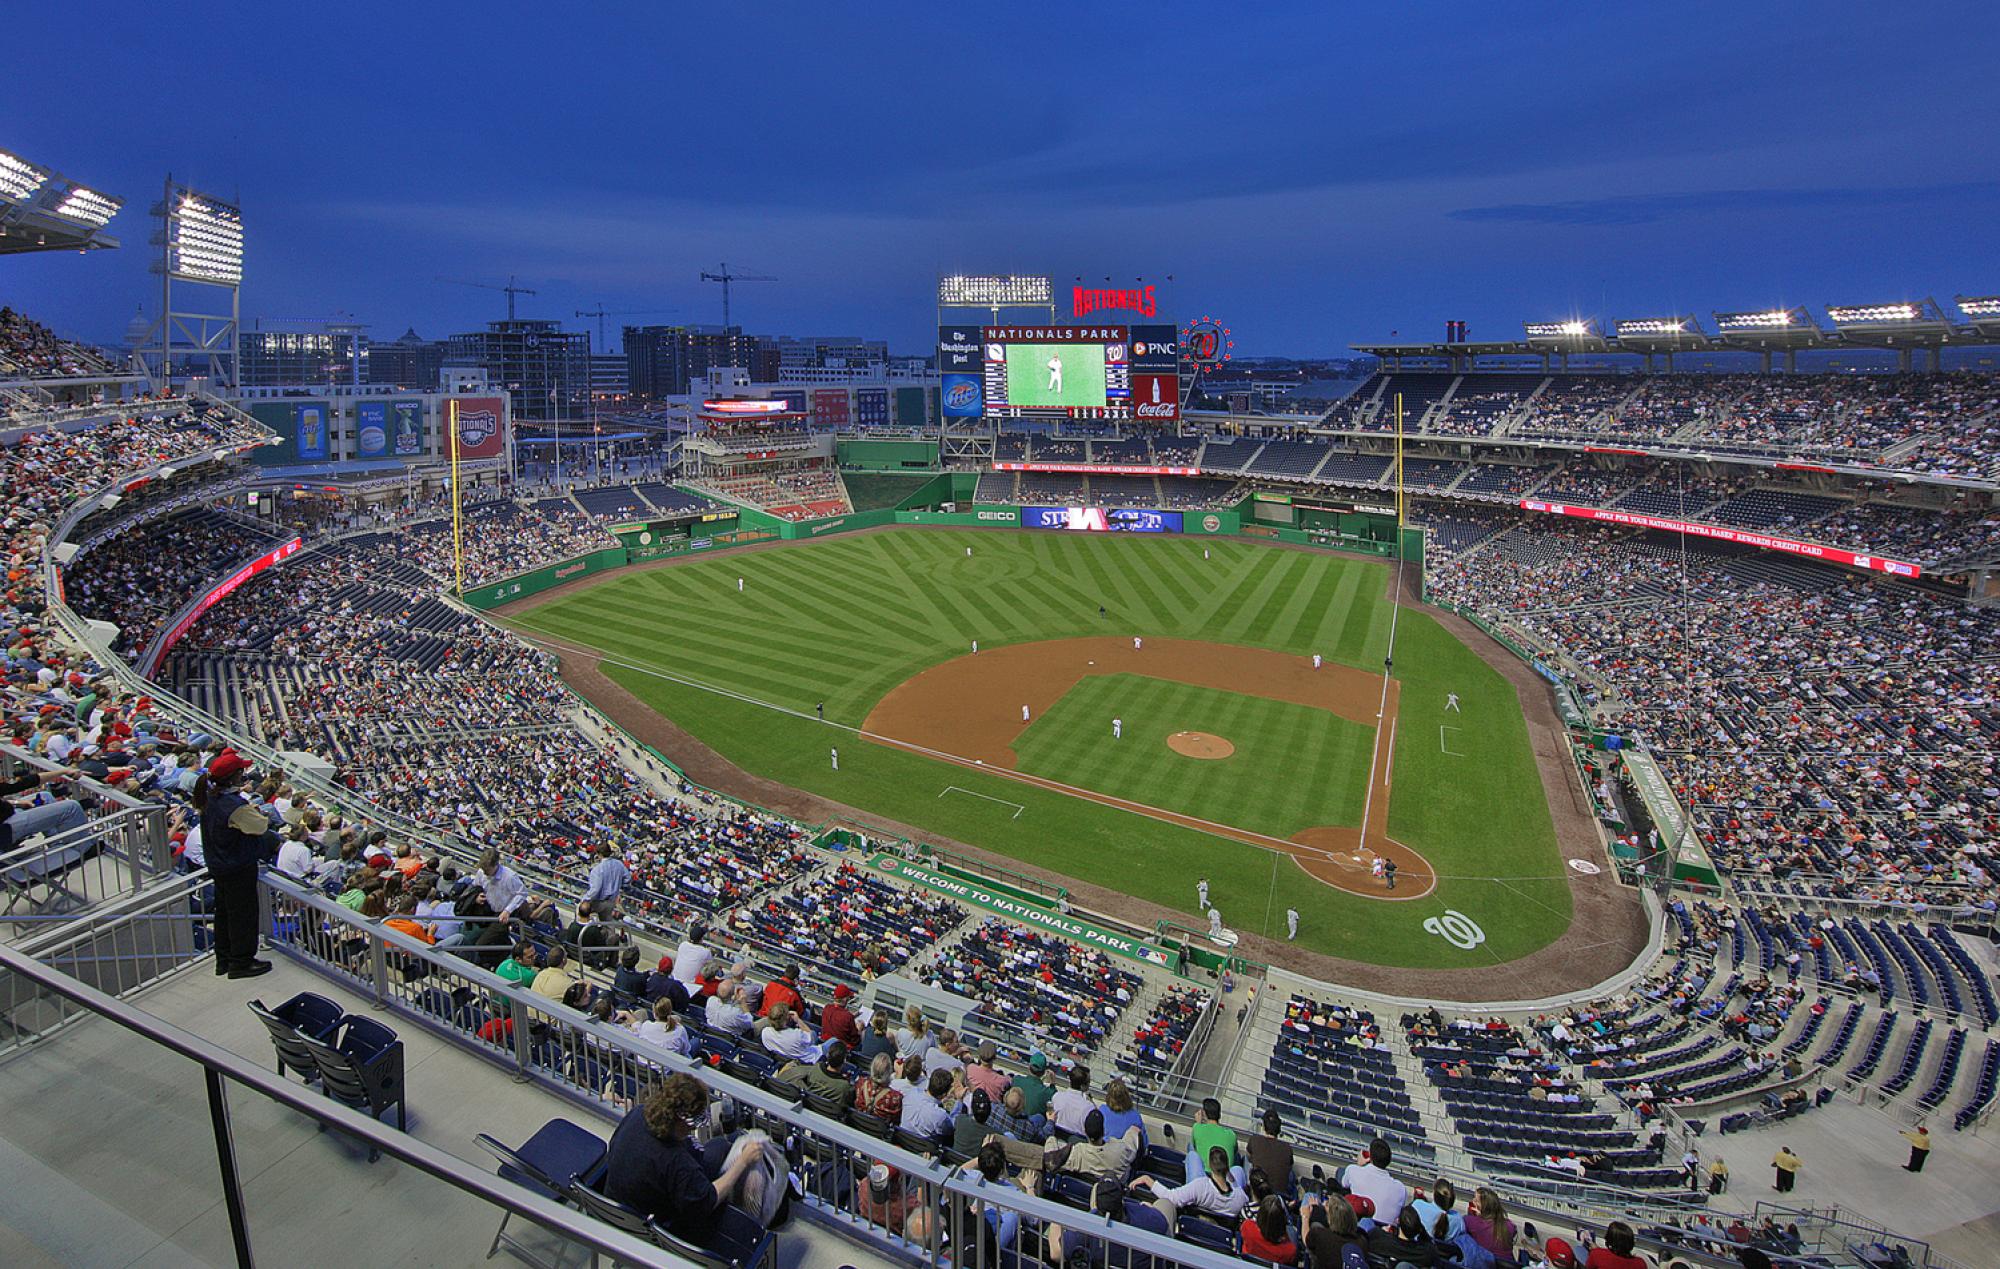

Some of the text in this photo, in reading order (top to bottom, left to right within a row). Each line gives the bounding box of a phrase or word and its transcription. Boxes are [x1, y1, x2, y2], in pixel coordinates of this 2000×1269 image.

[1073, 285, 1156, 318] NATIONALS
[953, 332, 966, 341] The
[988, 329, 1120, 339] NATIONALS PARK
[941, 343, 979, 352] Washington
[1148, 342, 1176, 355] PNC
[953, 355, 968, 365] Post
[978, 511, 1016, 520] GEICO
[1594, 511, 1614, 520] APPLY
[1616, 514, 1629, 522] FOR
[1630, 516, 1648, 525] YOUR
[1649, 520, 1686, 531] NATIONALS
[1686, 525, 1710, 535] EXTRA
[1737, 533, 1771, 546] REWARDS
[1772, 540, 1801, 552] CREDIT
[1802, 545, 1823, 556] CARD
[902, 866, 1133, 952] WELCOME TO NATIONALS PARK
[1423, 909, 1486, 950] W
